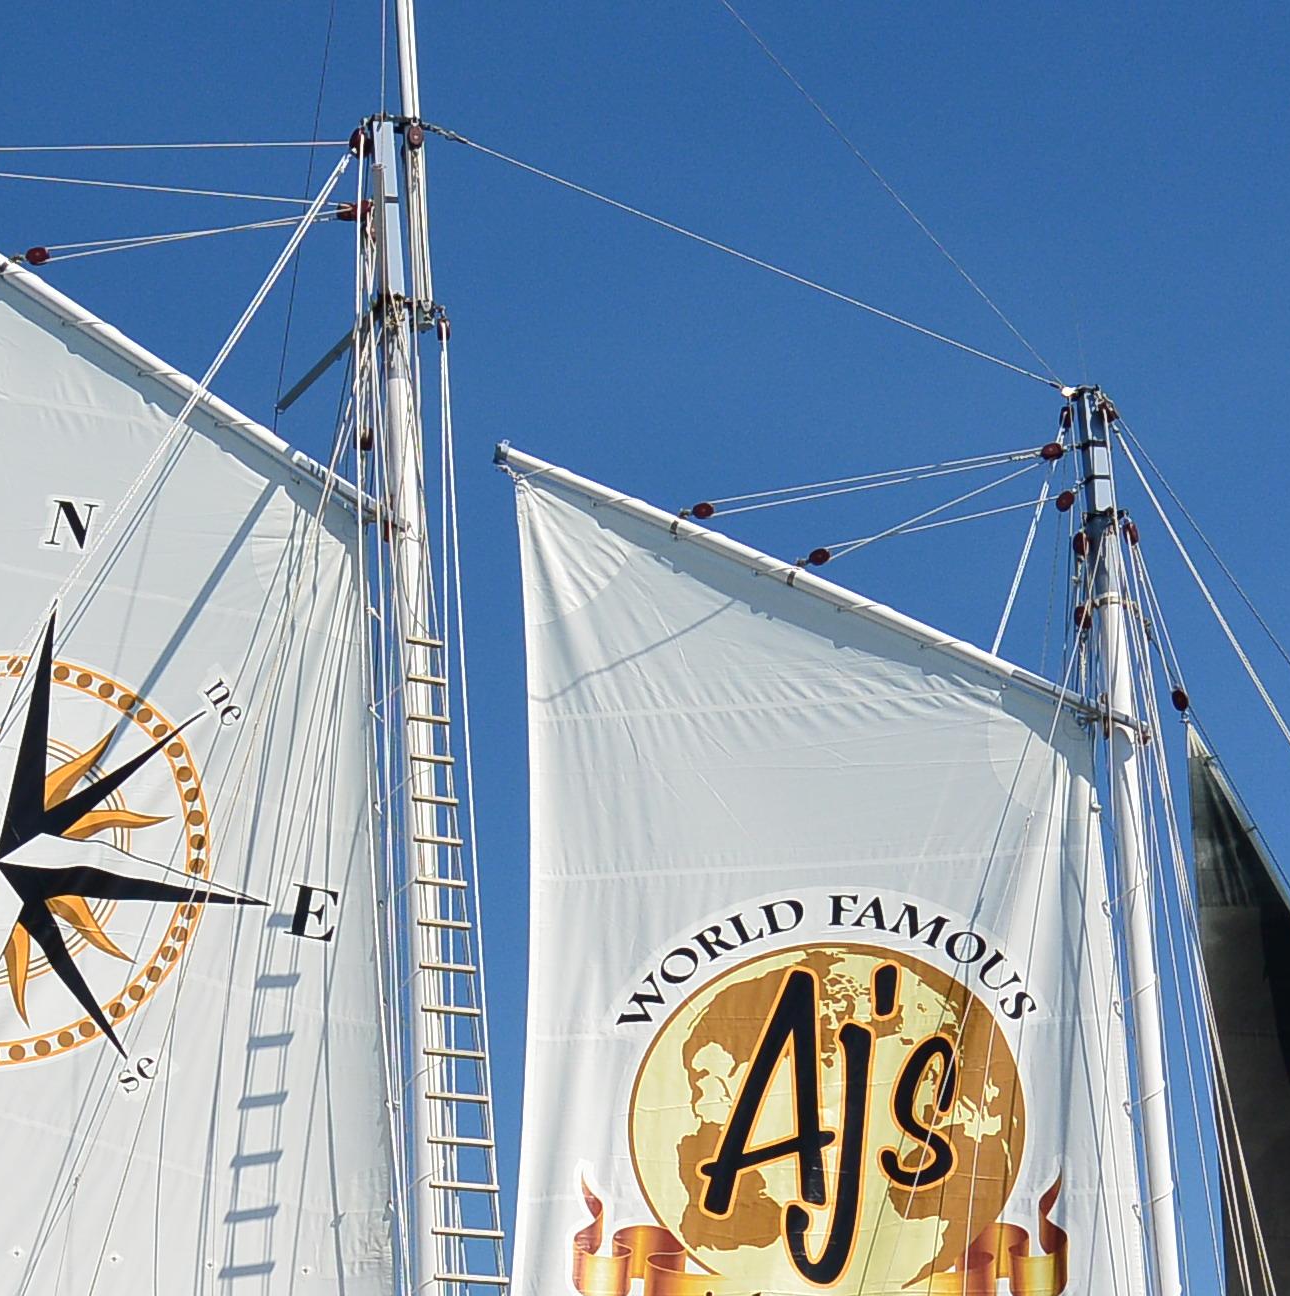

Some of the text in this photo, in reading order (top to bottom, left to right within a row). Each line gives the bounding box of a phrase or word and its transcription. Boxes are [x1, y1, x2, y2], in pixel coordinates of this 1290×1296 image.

[44, 499, 100, 549] N
[203, 675, 242, 727] ne
[284, 883, 339, 943] E
[616, 893, 1038, 1026] WORLD FAMOUS
[119, 1054, 157, 1095] se
